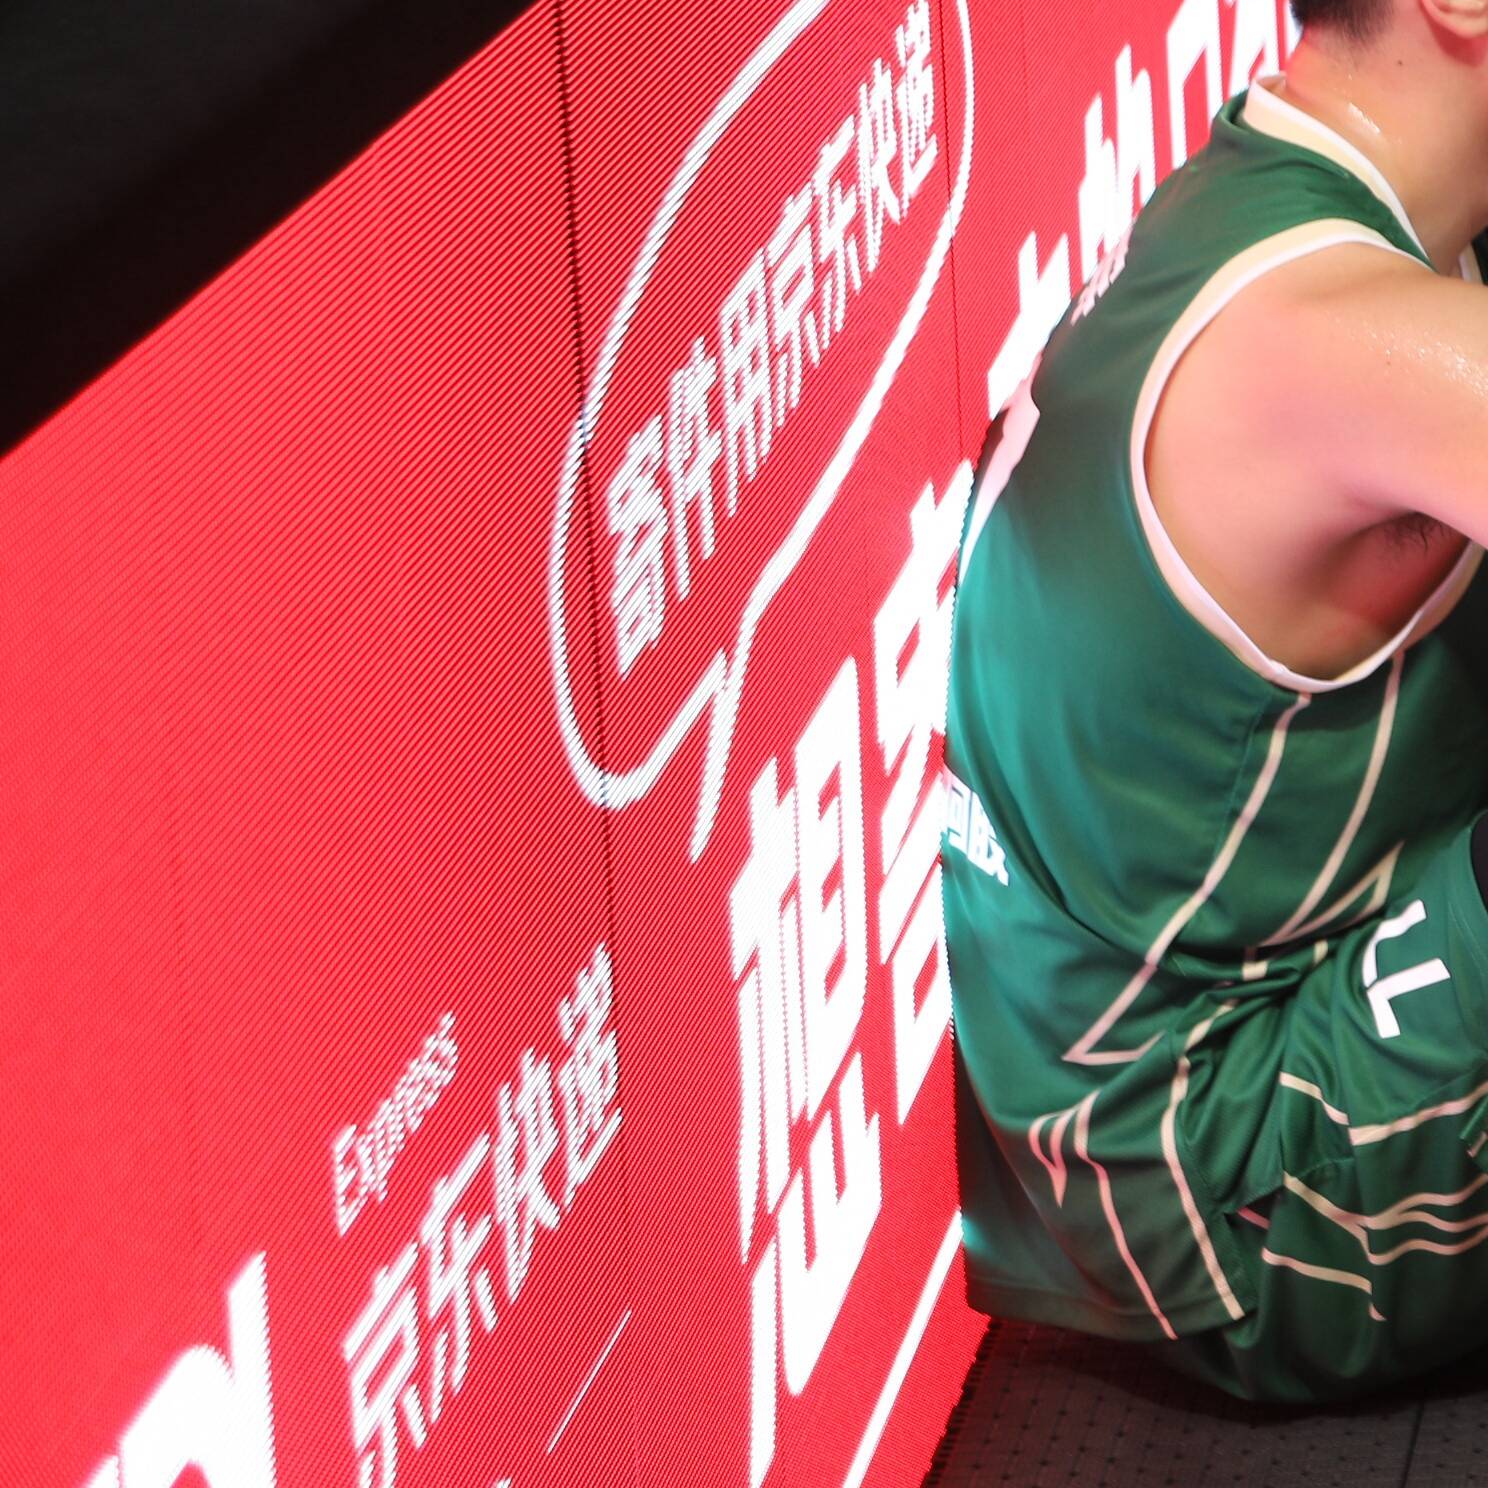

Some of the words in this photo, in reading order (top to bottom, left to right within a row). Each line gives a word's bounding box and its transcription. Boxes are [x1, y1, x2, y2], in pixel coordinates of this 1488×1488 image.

[332, 1010, 460, 1237] Express
[342, 942, 623, 1488] 京东快递
